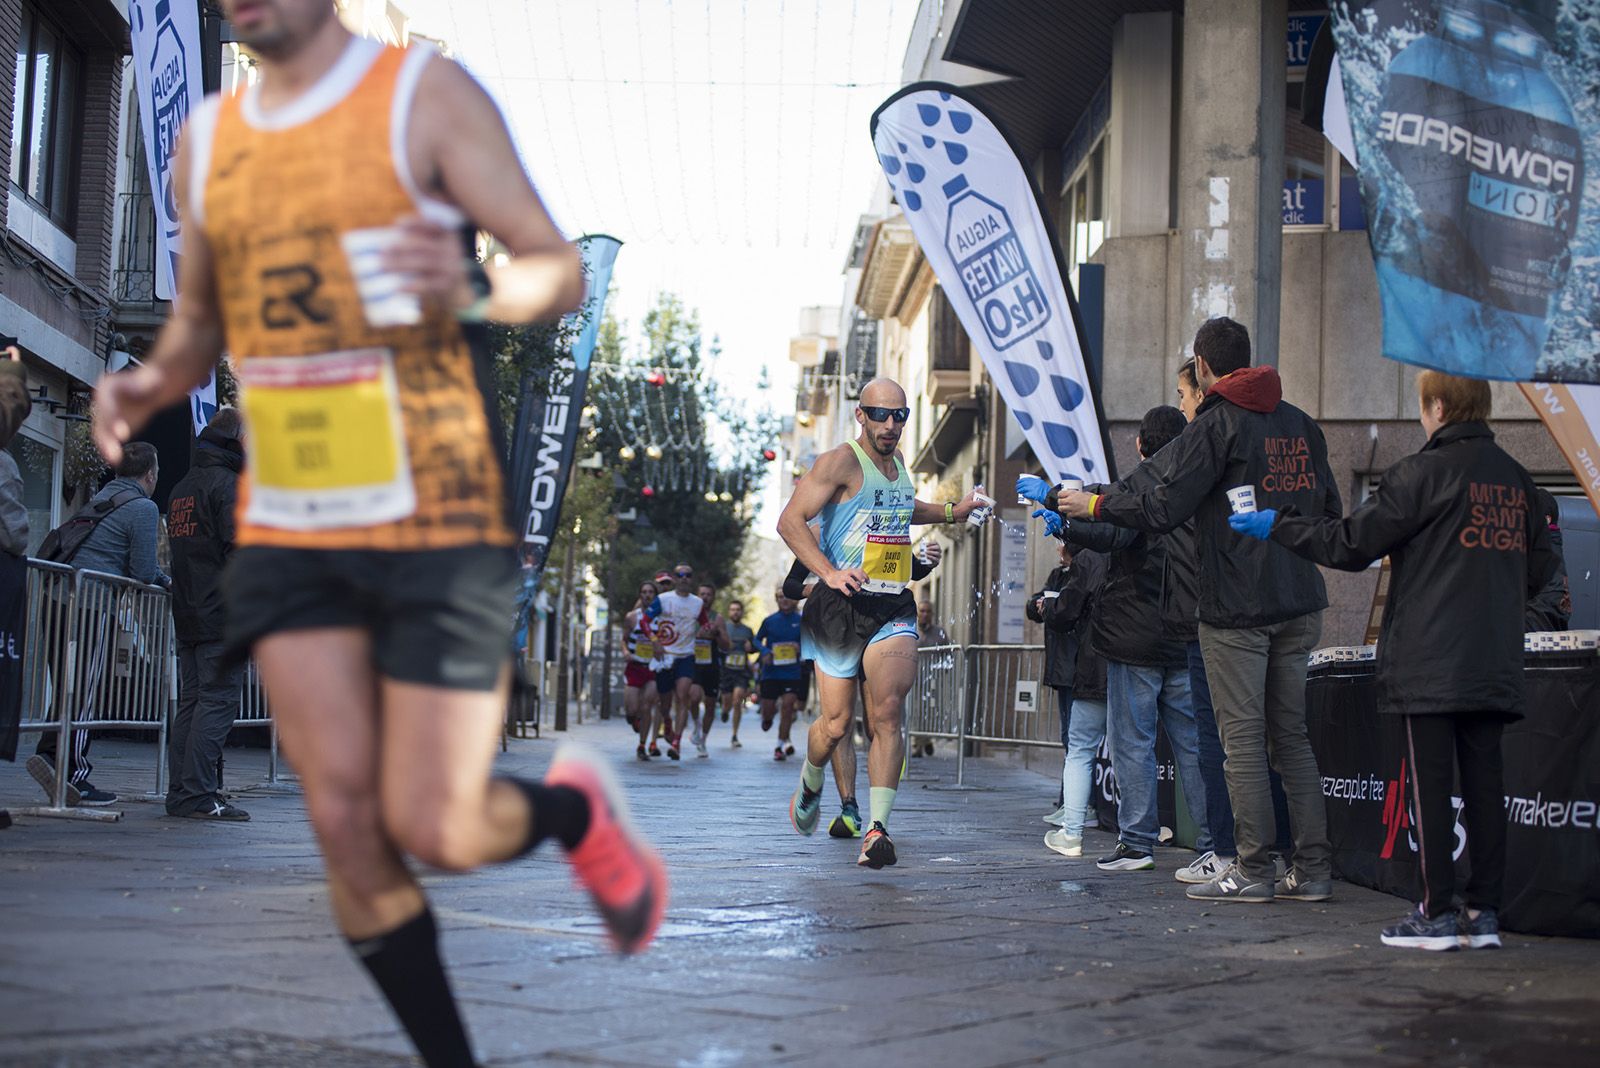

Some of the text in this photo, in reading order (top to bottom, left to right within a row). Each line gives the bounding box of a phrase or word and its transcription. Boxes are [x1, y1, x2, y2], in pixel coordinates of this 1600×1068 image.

[1264, 437, 1310, 455] MITJA
[1267, 455, 1309, 473] SANT
[1469, 482, 1528, 511] MITJA
[1471, 504, 1525, 529] SANT
[884, 551, 901, 561] DAVID
